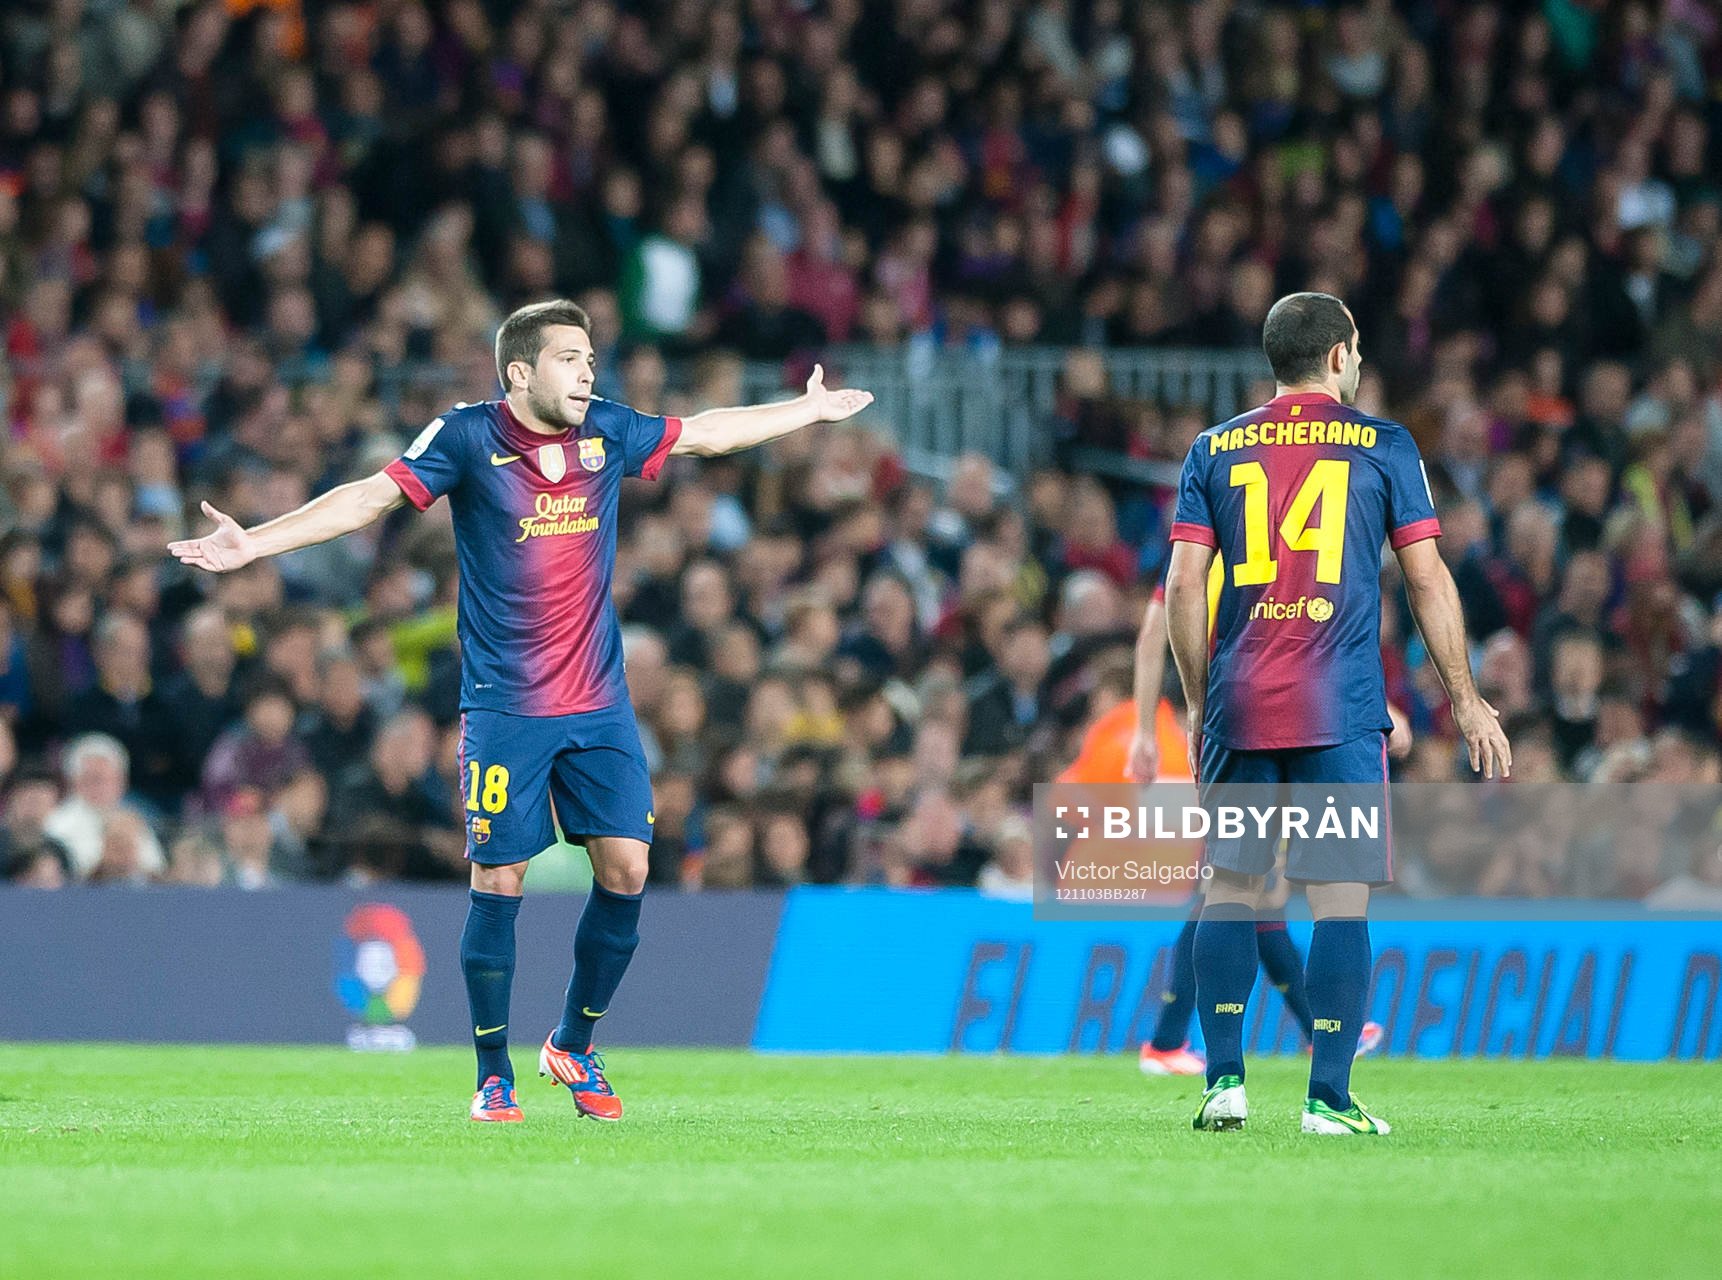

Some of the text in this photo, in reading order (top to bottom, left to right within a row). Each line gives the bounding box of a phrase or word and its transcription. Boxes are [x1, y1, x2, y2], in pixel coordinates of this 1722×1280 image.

[1210, 421, 1377, 455] MASCHERANO
[534, 493, 587, 520] Qatar
[1229, 459, 1350, 587] 14
[515, 513, 599, 543] Foundation
[466, 760, 510, 814] 18
